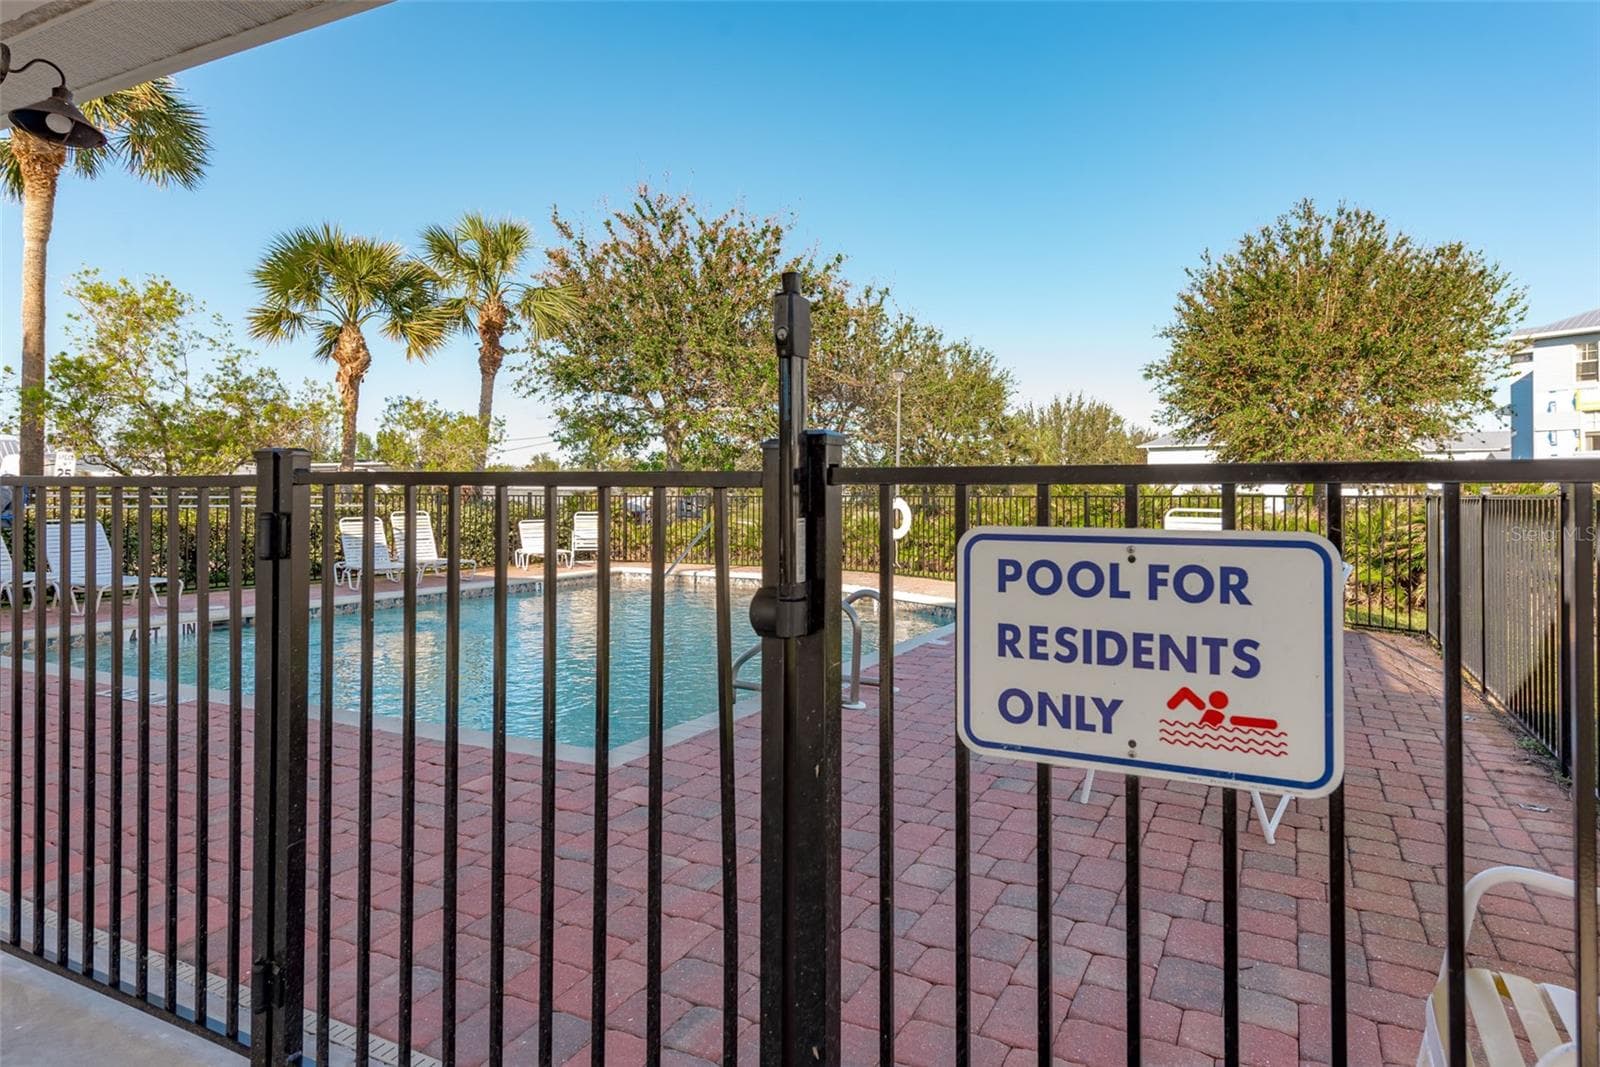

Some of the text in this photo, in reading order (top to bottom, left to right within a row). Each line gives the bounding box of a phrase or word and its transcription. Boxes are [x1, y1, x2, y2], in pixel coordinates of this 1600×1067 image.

[57, 468, 71, 478] 25
[997, 558, 1252, 606] POOL FOR
[182, 623, 196, 638] IN
[997, 623, 1261, 679] RESIDENTS
[997, 687, 1123, 734] ONLY
